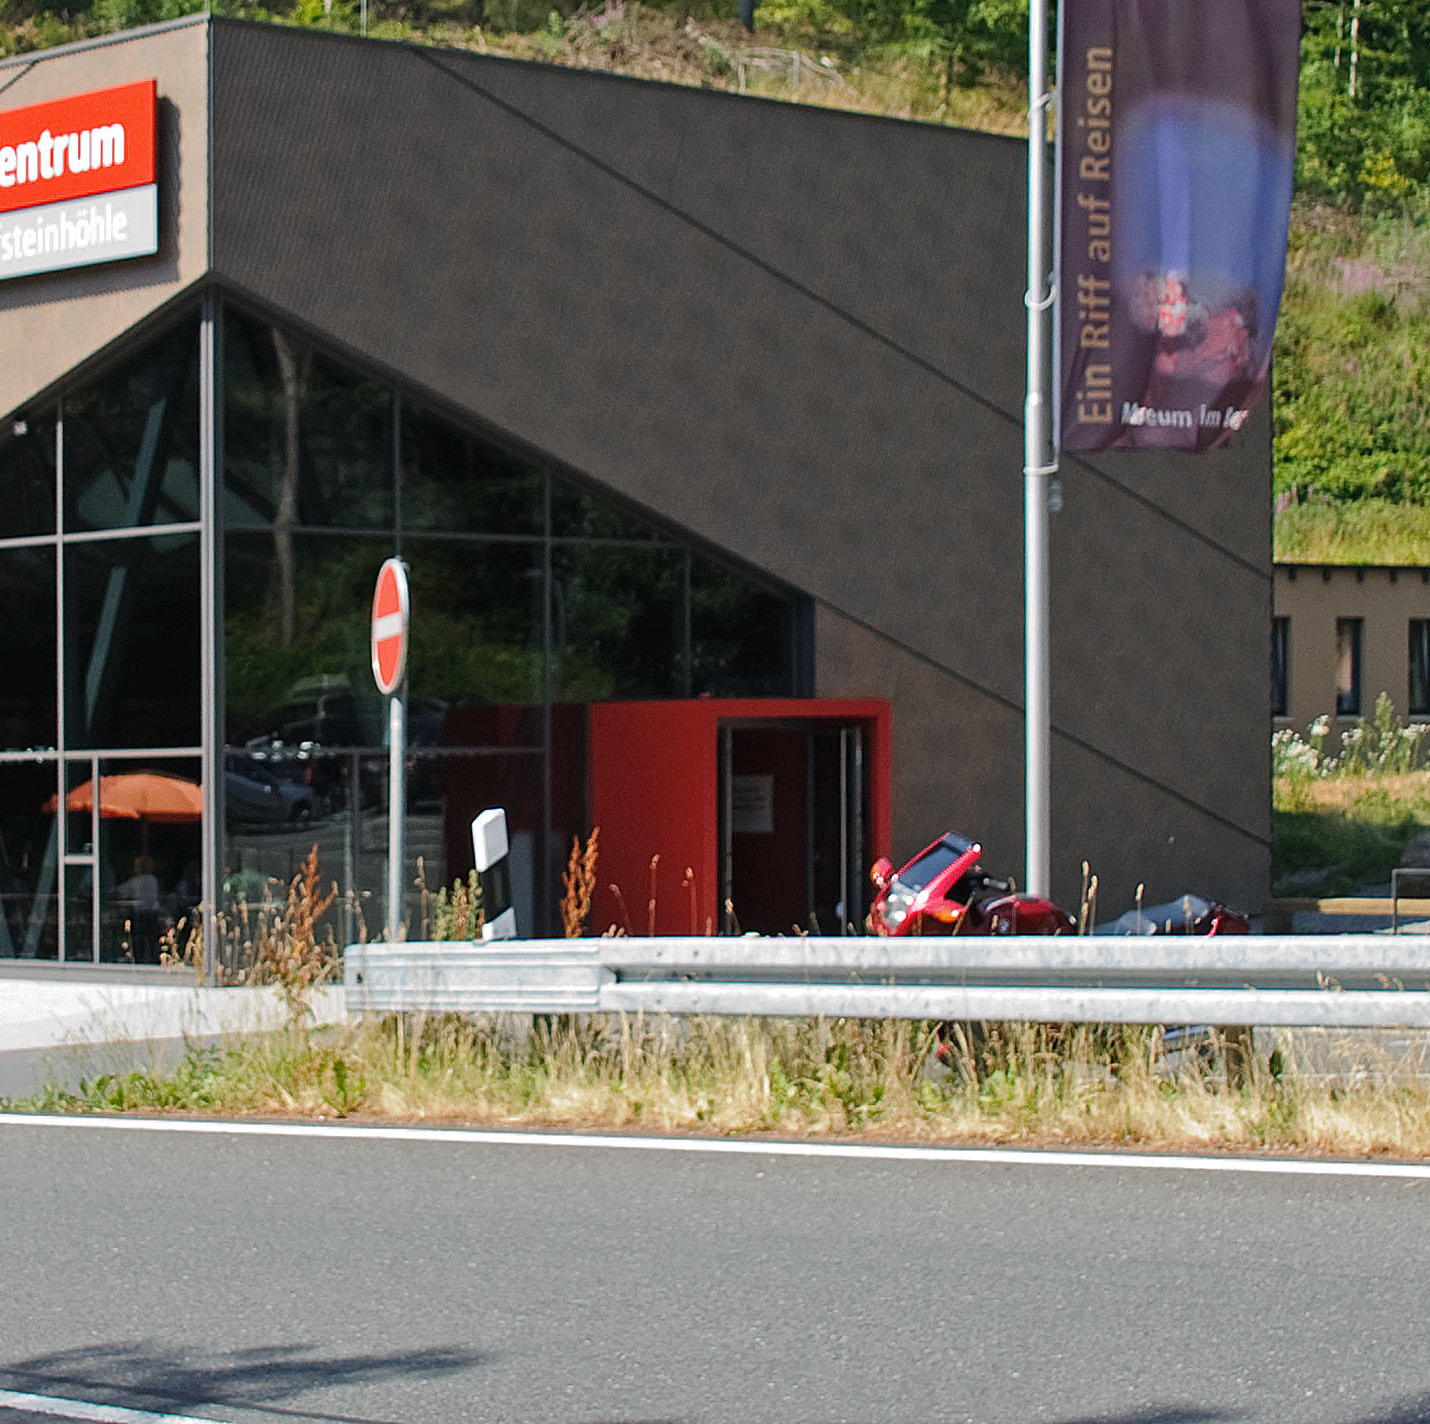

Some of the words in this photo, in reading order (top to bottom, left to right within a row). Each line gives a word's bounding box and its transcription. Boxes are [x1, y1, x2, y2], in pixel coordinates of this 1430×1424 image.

[1077, 46, 1114, 181] Reisen
[1078, 193, 1113, 262] auf
[1078, 274, 1112, 349] Riff
[1078, 363, 1114, 425] Ein
[1120, 401, 1192, 428] Meum
